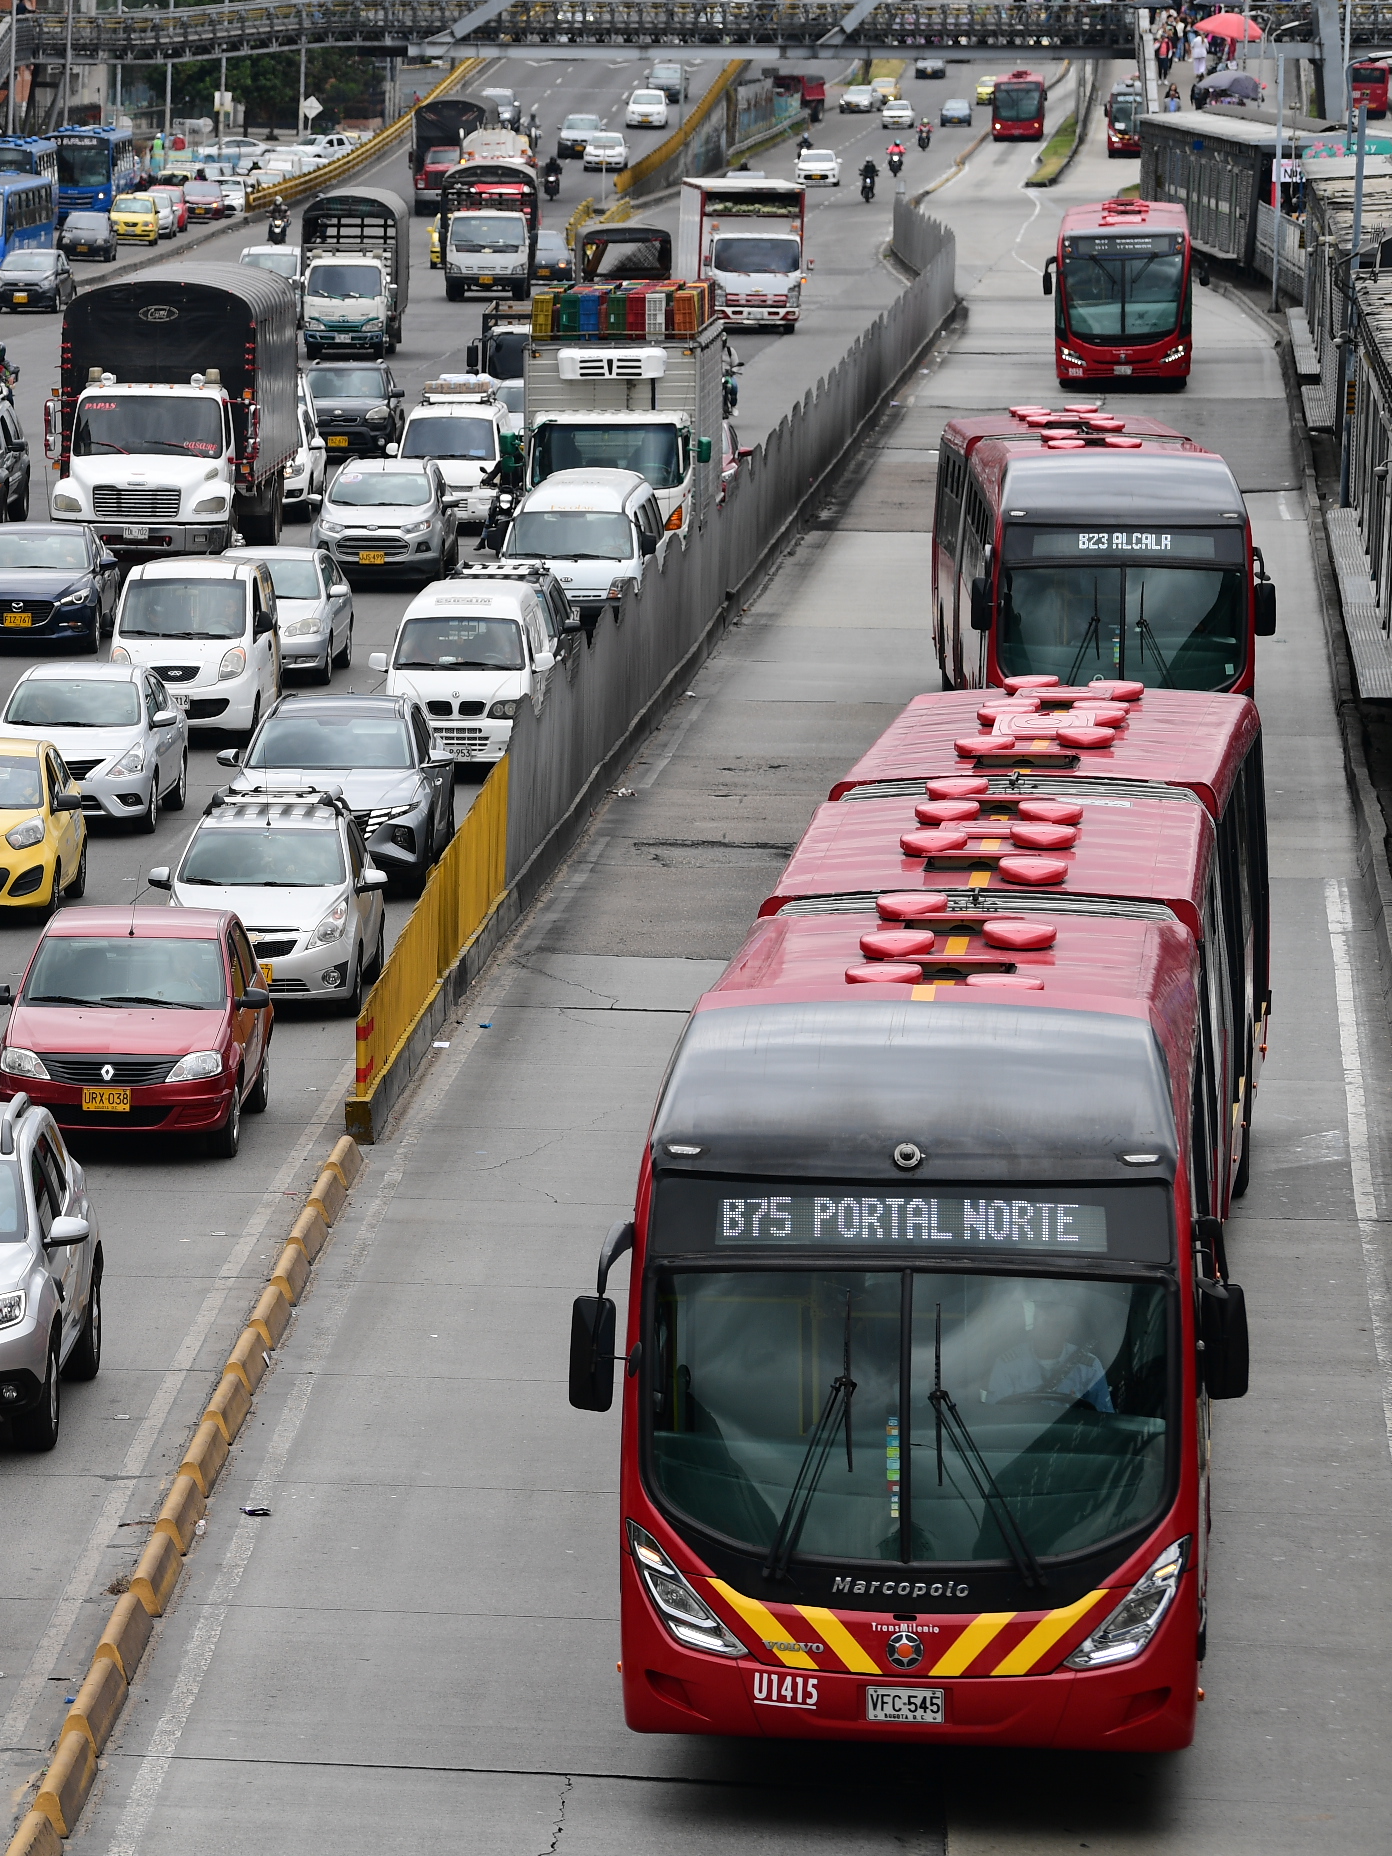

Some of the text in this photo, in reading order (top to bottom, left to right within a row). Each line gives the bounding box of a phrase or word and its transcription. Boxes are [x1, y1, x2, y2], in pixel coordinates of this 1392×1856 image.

[85, 402, 117, 410] PAPAS
[1078, 532, 1171, 551] B23 ALCALA
[721, 1196, 1080, 1243] B75 PORTAL NORTE
[831, 1575, 970, 1600] Marcopolo
[870, 1621, 940, 1635] TransMilenio
[762, 1638, 824, 1654] VOLVO
[753, 1671, 819, 1705] U1415
[884, 1713, 909, 1721] BOGOTA
